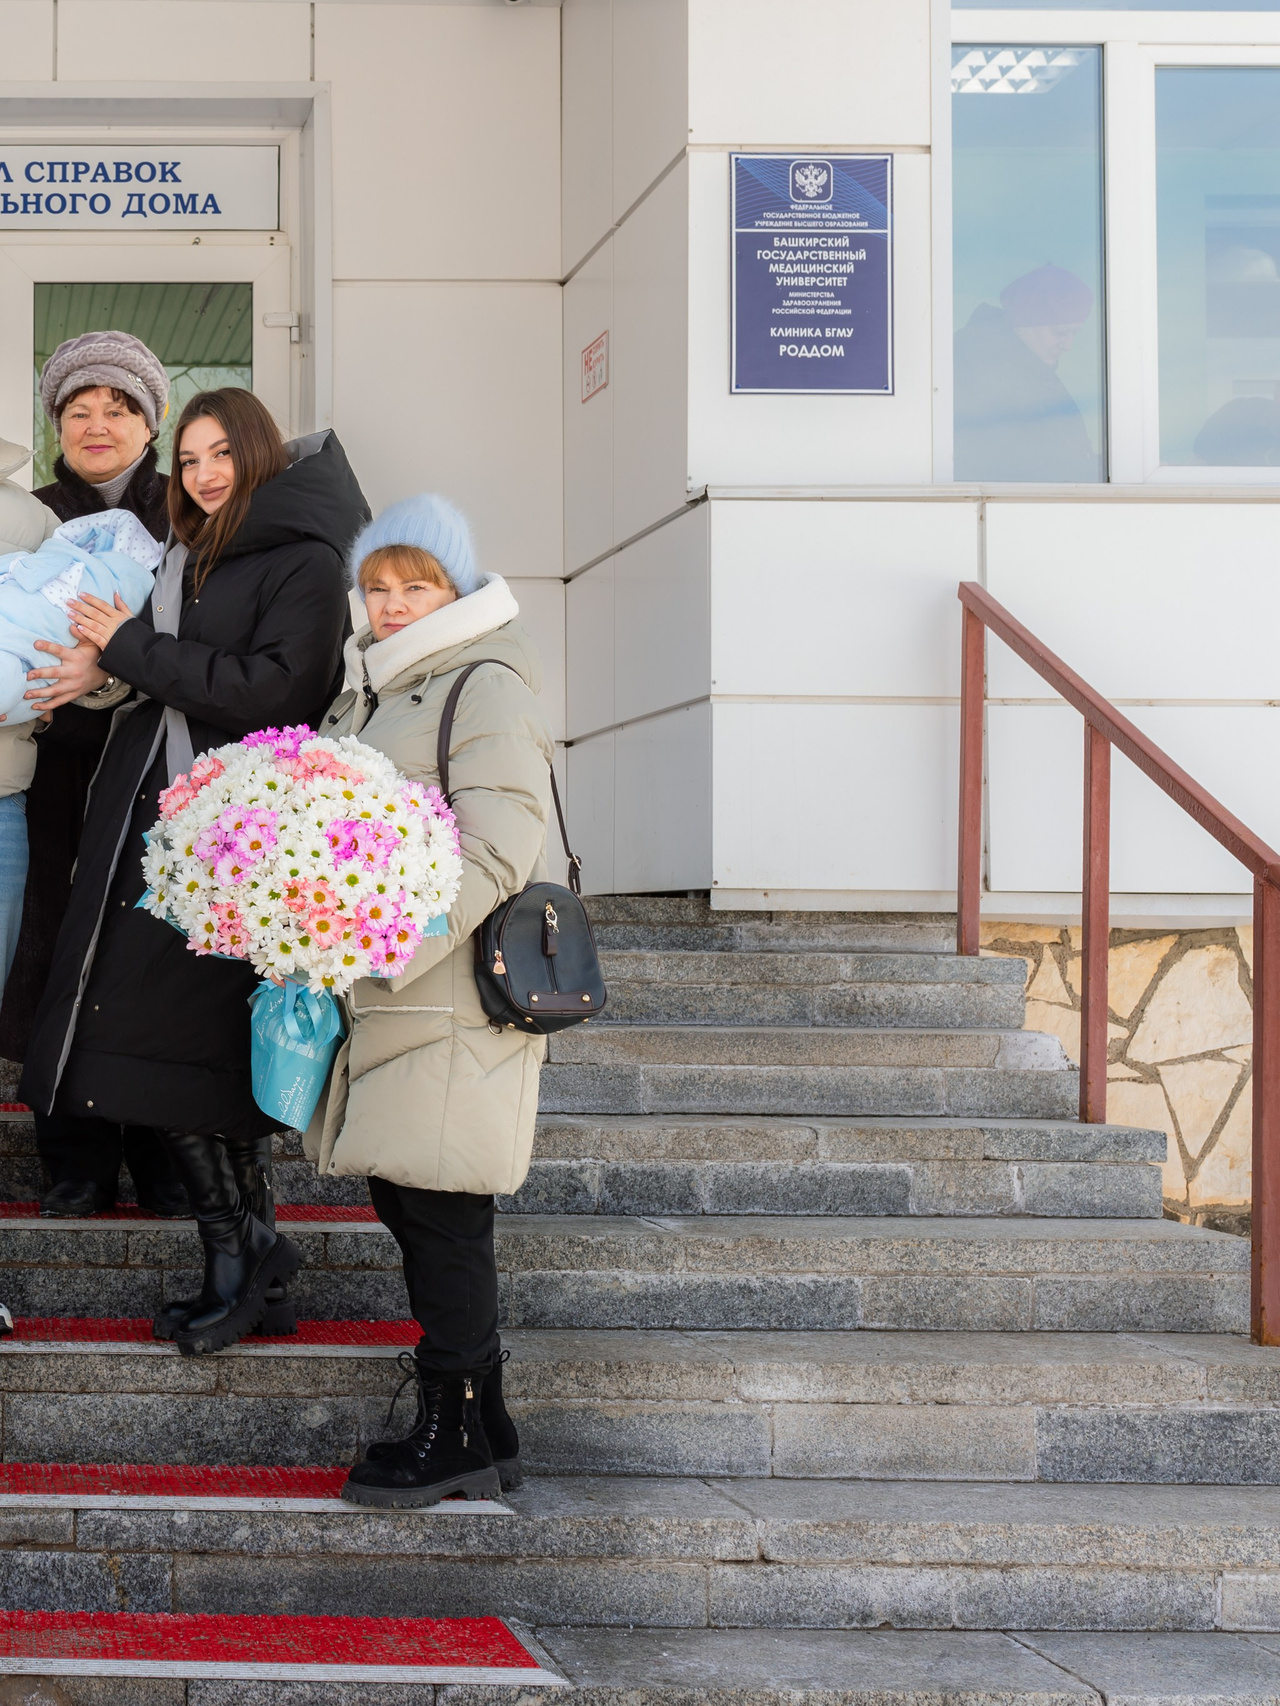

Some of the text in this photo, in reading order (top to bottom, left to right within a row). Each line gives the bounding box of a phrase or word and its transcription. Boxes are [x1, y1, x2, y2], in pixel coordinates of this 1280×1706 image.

[24, 161, 182, 184] СПРАВОК
[120, 192, 222, 218] ДОМА
[789, 203, 833, 211] ФЕДЕРАЛЬНОЕ
[754, 220, 869, 228] УЧРЕЖДЕНИЕ ВЫСШЕГО ОБРАЗОВАНИЯ
[773, 235, 850, 248] БАШКИРСКИЙ
[756, 249, 867, 262] ГОСУДАРСТВЕННЫЙ
[768, 261, 855, 275] МЕДИЦИНСКИЙ
[775, 276, 849, 287] УНИВЕРСИТЕТ
[771, 307, 852, 316] РОССИЙСКОЙ ФЕДЕРАЦИИ
[770, 326, 854, 339] КЛИНИКА БГМУ
[779, 344, 845, 358] РОДДОМ
